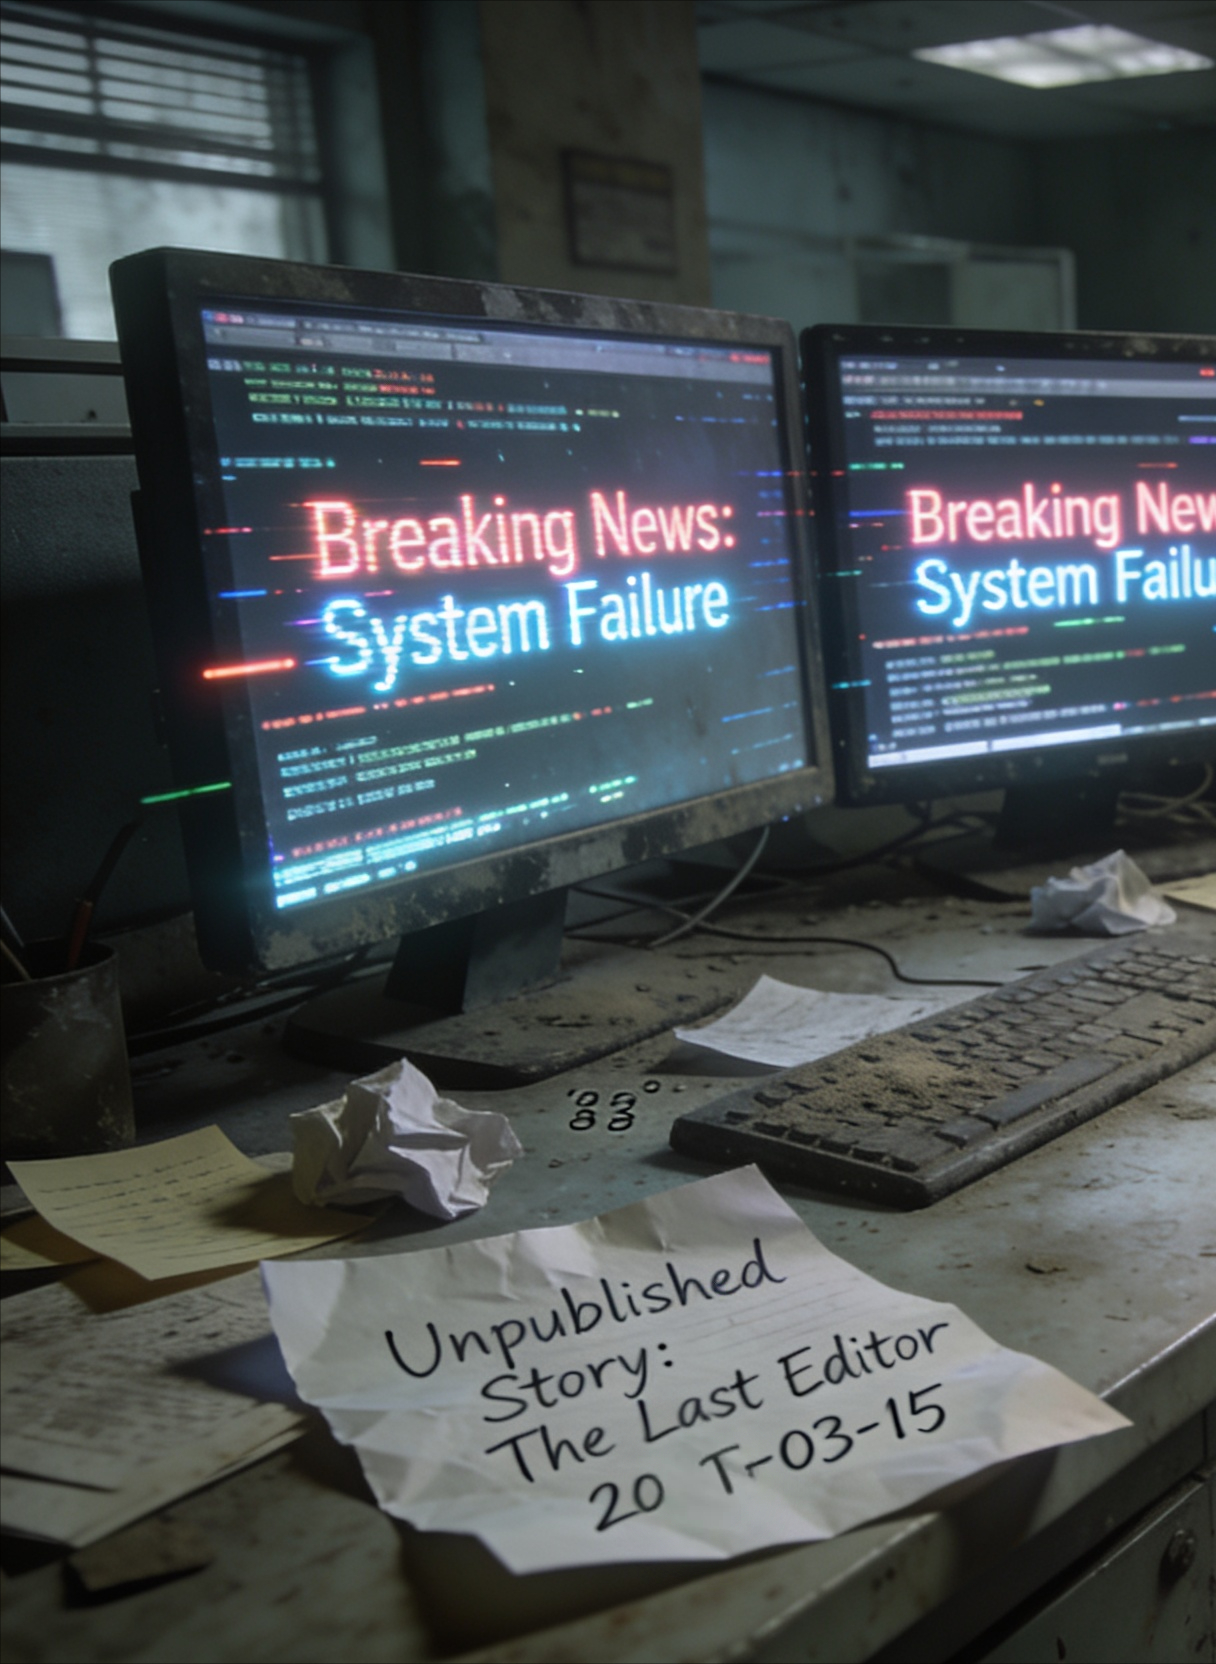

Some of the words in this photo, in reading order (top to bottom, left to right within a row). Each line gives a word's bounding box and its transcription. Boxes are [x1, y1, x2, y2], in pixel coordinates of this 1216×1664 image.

[308, 493, 576, 578] Breaking
[590, 490, 736, 557] News:
[907, 482, 1121, 547] Breaking
[322, 593, 551, 692] System
[564, 572, 731, 646] Failure
[915, 558, 1099, 628] System
[385, 1237, 788, 1379] Unpublished
[481, 1340, 676, 1424] Story:
[485, 1429, 616, 1484] The
[638, 1368, 765, 1445] Last
[776, 1317, 951, 1398] Editor
[588, 1472, 665, 1533] 20
